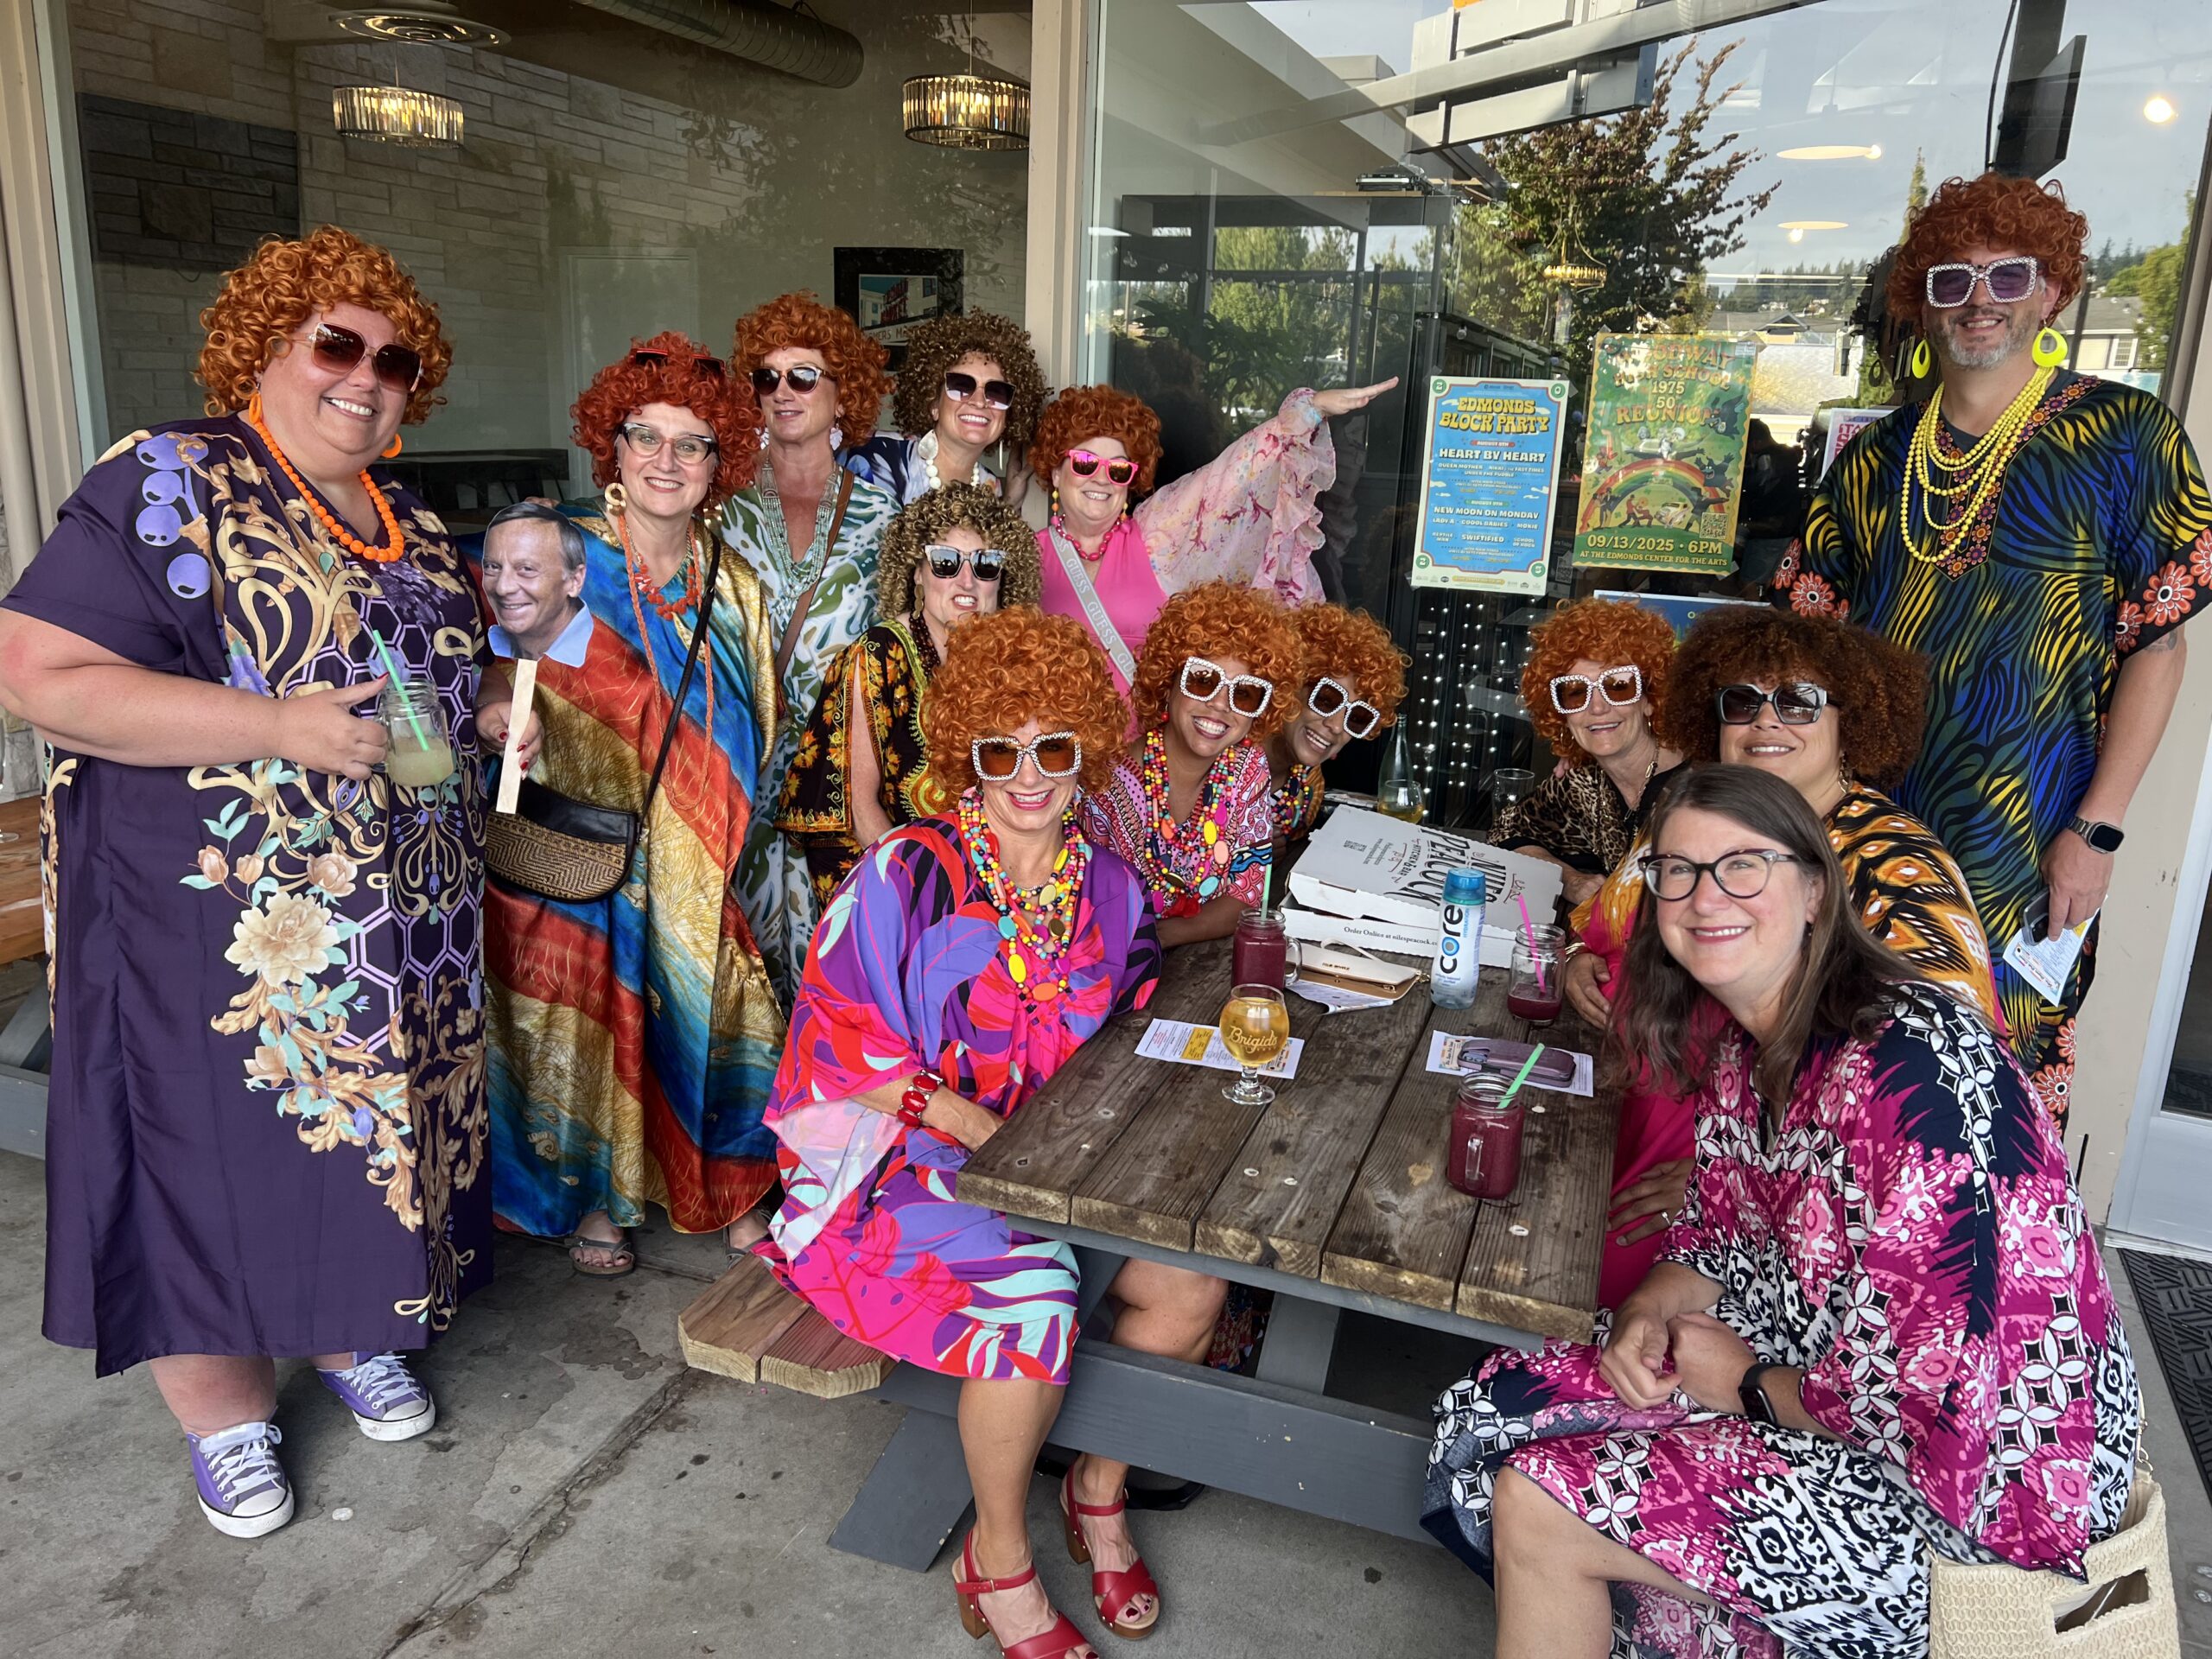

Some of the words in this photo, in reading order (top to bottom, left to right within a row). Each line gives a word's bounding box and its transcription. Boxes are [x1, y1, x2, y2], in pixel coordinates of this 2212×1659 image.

[1435, 381, 1444, 391] 2
[1651, 380, 1685, 395] 1975
[1457, 397, 1535, 415] EDMONDS
[1656, 397, 1676, 410] 50
[1439, 412, 1494, 433] BLOCK
[1496, 414, 1550, 435] PARTY
[1438, 448, 1481, 461] HEART
[1483, 450, 1502, 462] BY
[1503, 451, 1547, 464] HEART
[1433, 506, 1454, 515] NEW
[1455, 508, 1484, 517] MOON
[1499, 510, 1540, 520] MONDAY
[1461, 534, 1505, 543] SWIFTIFIED
[1587, 534, 1675, 553] 09/13/2025
[1688, 539, 1723, 555] 6PM
[1591, 551, 1605, 560] THE
[1606, 551, 1643, 561] EDMONDS
[1691, 556, 1708, 565] THE
[1066, 557, 1090, 594] GUESS
[1087, 601, 1117, 645] GUESS
[1363, 930, 1384, 938] Online
[1440, 905, 1464, 975] core
